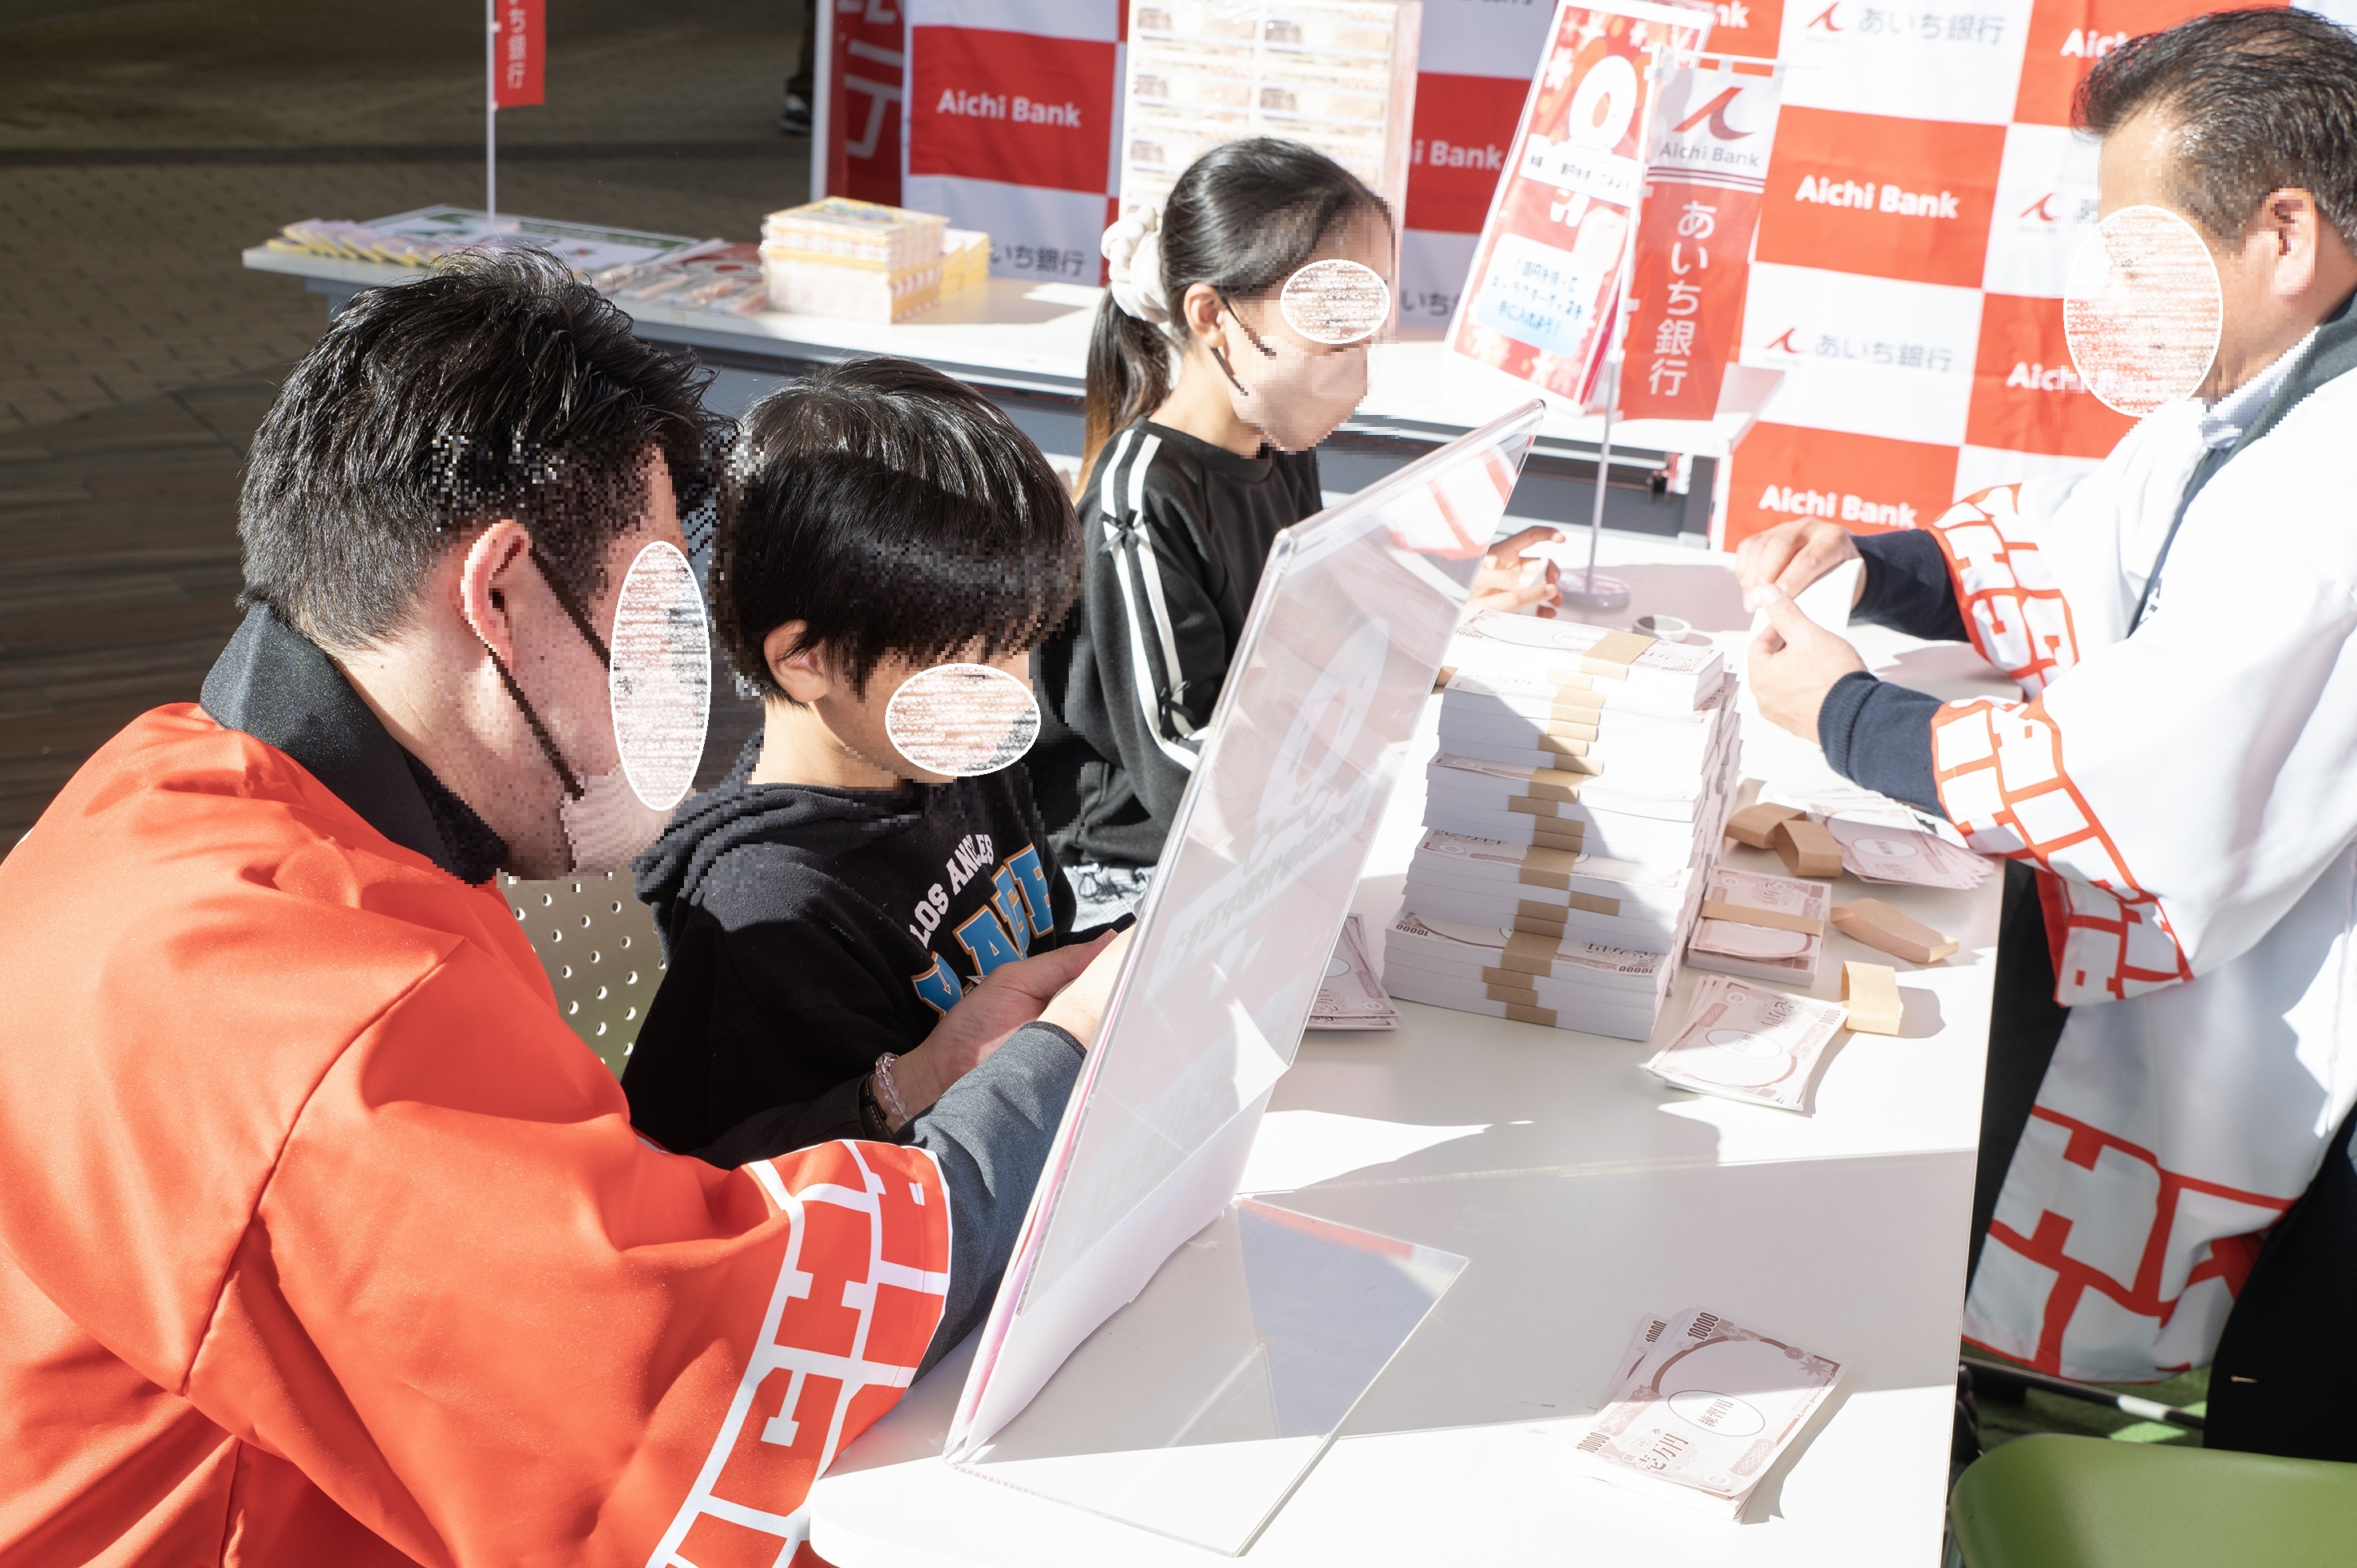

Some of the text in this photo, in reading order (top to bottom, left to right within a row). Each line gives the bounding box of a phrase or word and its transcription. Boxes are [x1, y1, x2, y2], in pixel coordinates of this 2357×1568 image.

[507, 0, 527, 89] ち銀行
[1858, 7, 2006, 45] あいち銀行
[935, 88, 1082, 128] Aichi Bank
[1429, 139, 1503, 171] Bank
[1660, 142, 1759, 168] Aichi Bank
[1794, 174, 1960, 219] Aichi Bank
[990, 242, 1086, 278] いち銀行
[1648, 200, 1718, 397] あいち銀行
[1815, 334, 1953, 372] あいち銀行
[1758, 484, 1918, 529] Aichi Bank
[909, 883, 949, 949] LOS
[1395, 923, 1429, 937] 10000
[1687, 1312, 1718, 1341] 10000
[1698, 1398, 1734, 1427] 練習用
[1576, 1432, 1610, 1453] 10000
[1637, 1433, 1690, 1470] 壱万円
